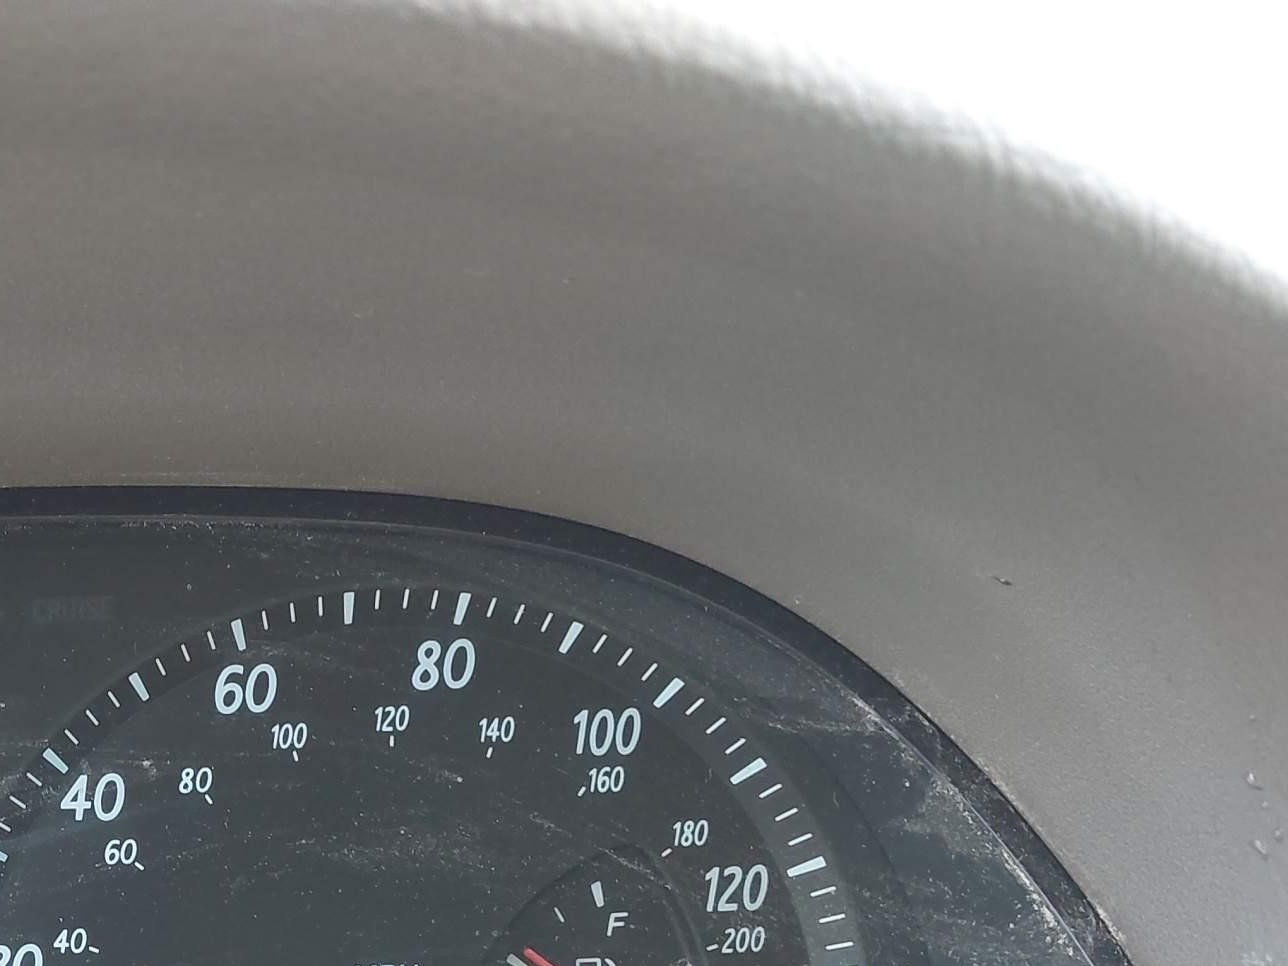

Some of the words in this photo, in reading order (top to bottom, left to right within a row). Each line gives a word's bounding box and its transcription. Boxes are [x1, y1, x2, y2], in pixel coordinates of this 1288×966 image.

[411, 638, 476, 690] 80
[214, 663, 277, 714] 60
[374, 705, 410, 733] 120
[478, 716, 515, 742] 140
[572, 707, 642, 755] 100
[270, 723, 308, 750] 100
[178, 767, 212, 794] 80
[588, 766, 625, 793] 160
[60, 773, 126, 821] 40
[672, 820, 709, 847] 180
[104, 839, 138, 866] 60
[705, 864, 769, 912] 120
[607, 912, 629, 937] F
[53, 928, 87, 954] 40
[721, 926, 766, 954] 200
